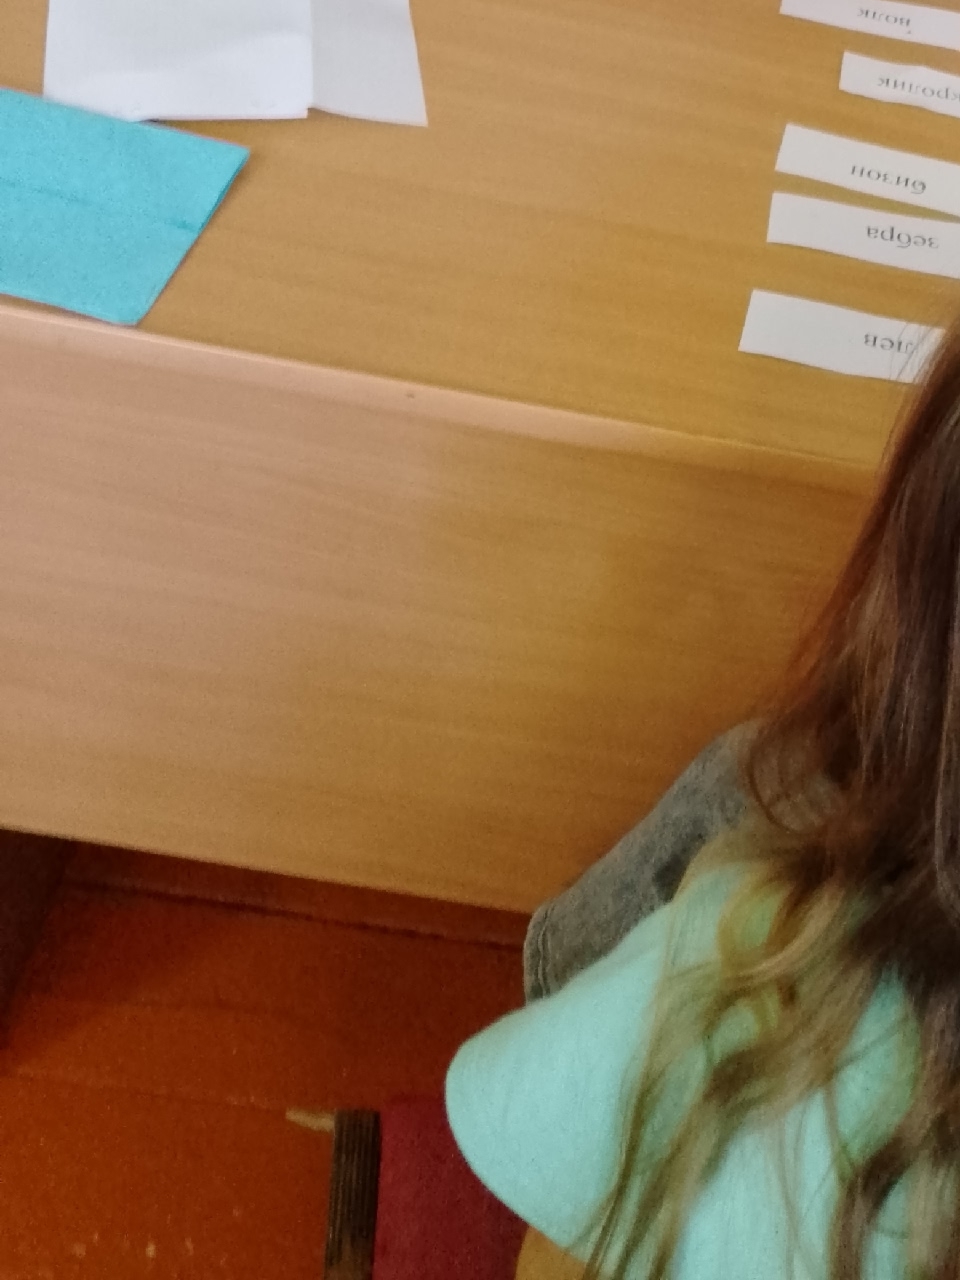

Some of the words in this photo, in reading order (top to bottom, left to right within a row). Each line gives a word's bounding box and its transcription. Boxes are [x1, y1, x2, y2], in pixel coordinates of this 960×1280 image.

[857, 7, 911, 28] волк
[850, 165, 927, 195] бизон
[866, 225, 940, 250] зебра
[863, 332, 918, 358] лев
